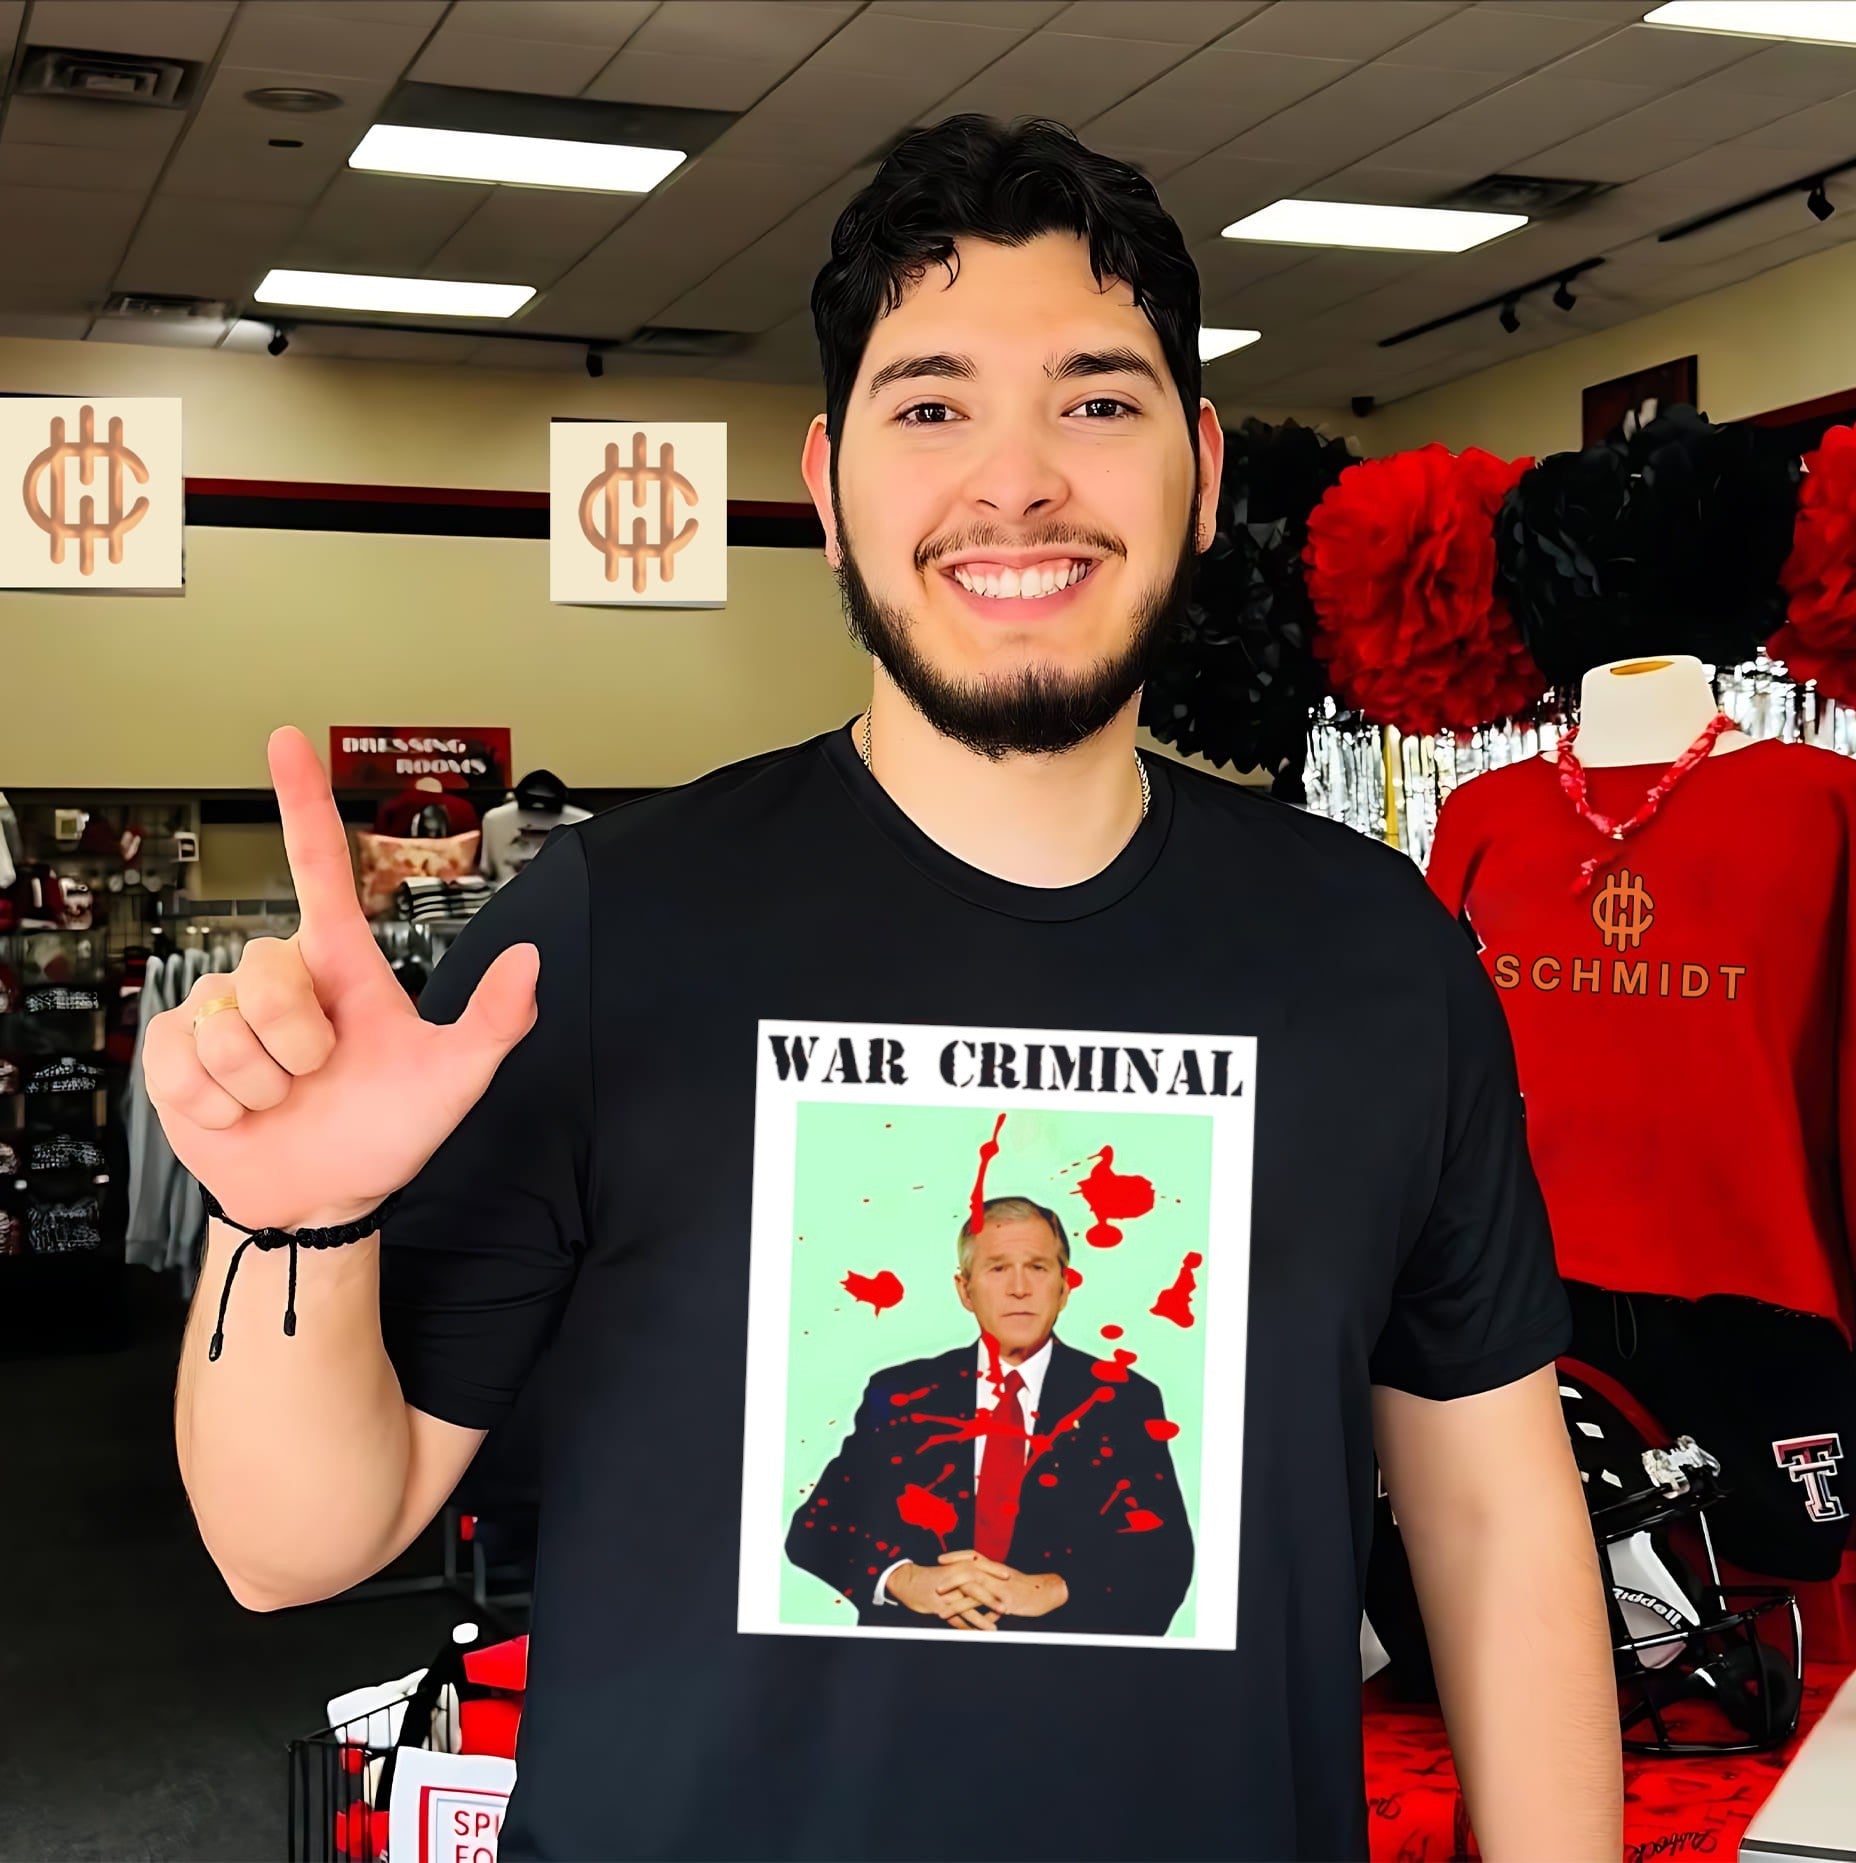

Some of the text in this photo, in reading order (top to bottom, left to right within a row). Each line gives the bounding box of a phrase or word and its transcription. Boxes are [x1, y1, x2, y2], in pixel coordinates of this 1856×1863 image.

[342, 736, 467, 754] DRESSING
[396, 758, 487, 775] ROOMS
[1493, 953, 1748, 1001] SCHMIDT
[768, 1035, 1244, 1098] WAR CRIMINAL
